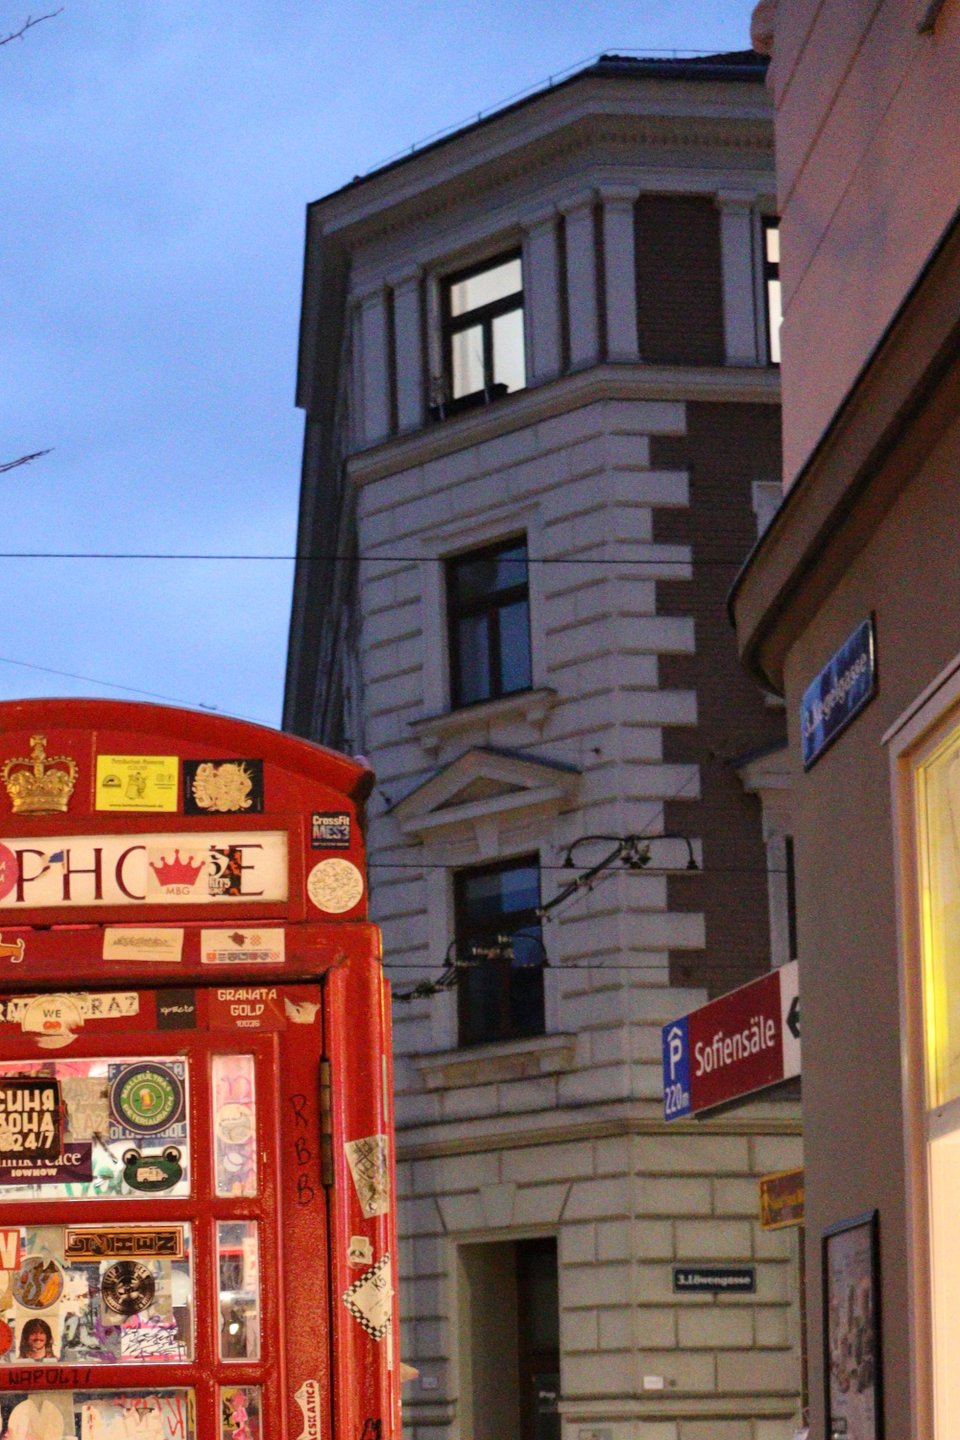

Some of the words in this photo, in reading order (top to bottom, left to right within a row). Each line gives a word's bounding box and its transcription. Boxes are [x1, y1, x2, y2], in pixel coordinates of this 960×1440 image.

[312, 815, 350, 826] CrossFit
[166, 886, 190, 896] MBG
[217, 989, 277, 1001] GRANATA
[43, 1009, 62, 1018] WE
[230, 1004, 264, 1017] GOLD
[694, 1015, 775, 1077] Sofiensäle
[669, 1038, 683, 1080] P
